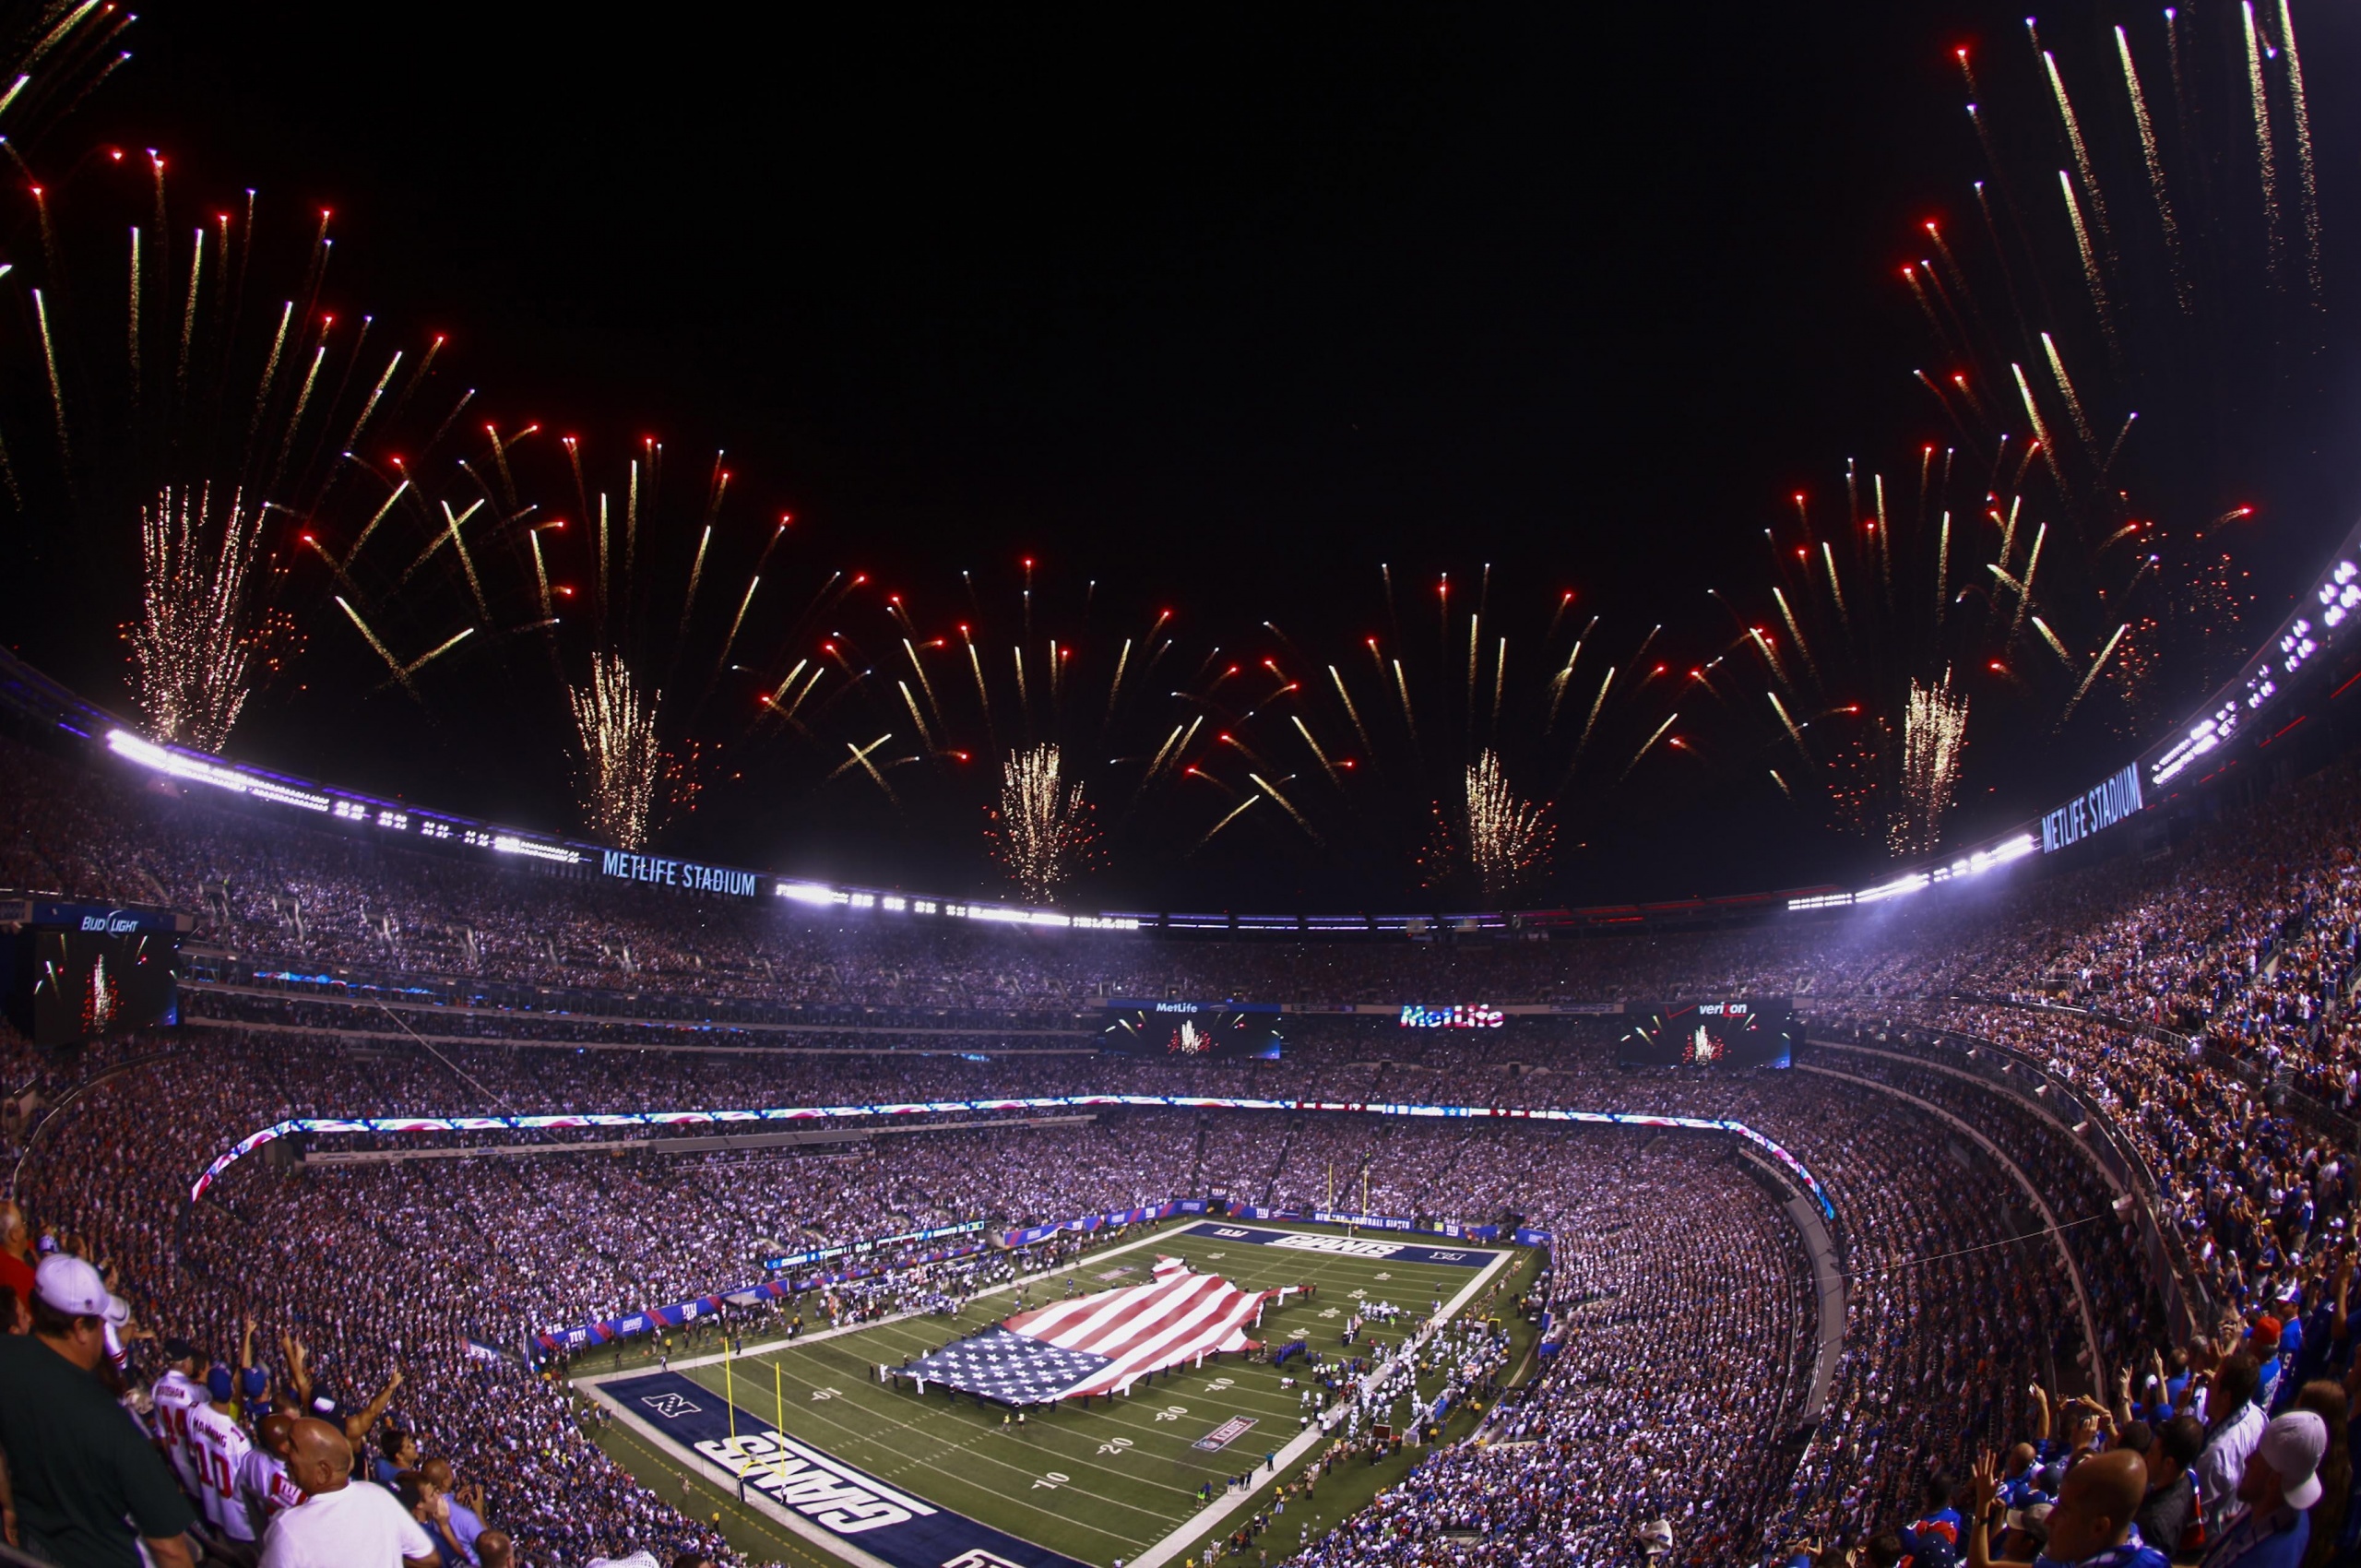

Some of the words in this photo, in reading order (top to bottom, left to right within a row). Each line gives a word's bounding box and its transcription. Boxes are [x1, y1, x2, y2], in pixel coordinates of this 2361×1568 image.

[2042, 796, 2088, 854] METLIFE
[2088, 761, 2143, 833] STADIUM
[602, 850, 677, 885] METLIFE
[682, 864, 755, 897] STADIUM
[81, 916, 105, 932] BUD
[110, 920, 139, 932] LIGHT
[1156, 1003, 1198, 1013] MetLife
[1399, 1004, 1505, 1028] MetLife
[1699, 1002, 1748, 1017] verizon
[1352, 1217, 1383, 1227] FOOTBALL
[1274, 1235, 1406, 1257] GIANTS
[1209, 1377, 1235, 1391] 40
[1158, 1406, 1188, 1421] 30
[192, 1416, 228, 1448] MANNING
[1102, 1437, 1134, 1455] 20
[196, 1442, 232, 1499] 10
[694, 1434, 913, 1534] GIANTS
[1038, 1472, 1070, 1490] 10
